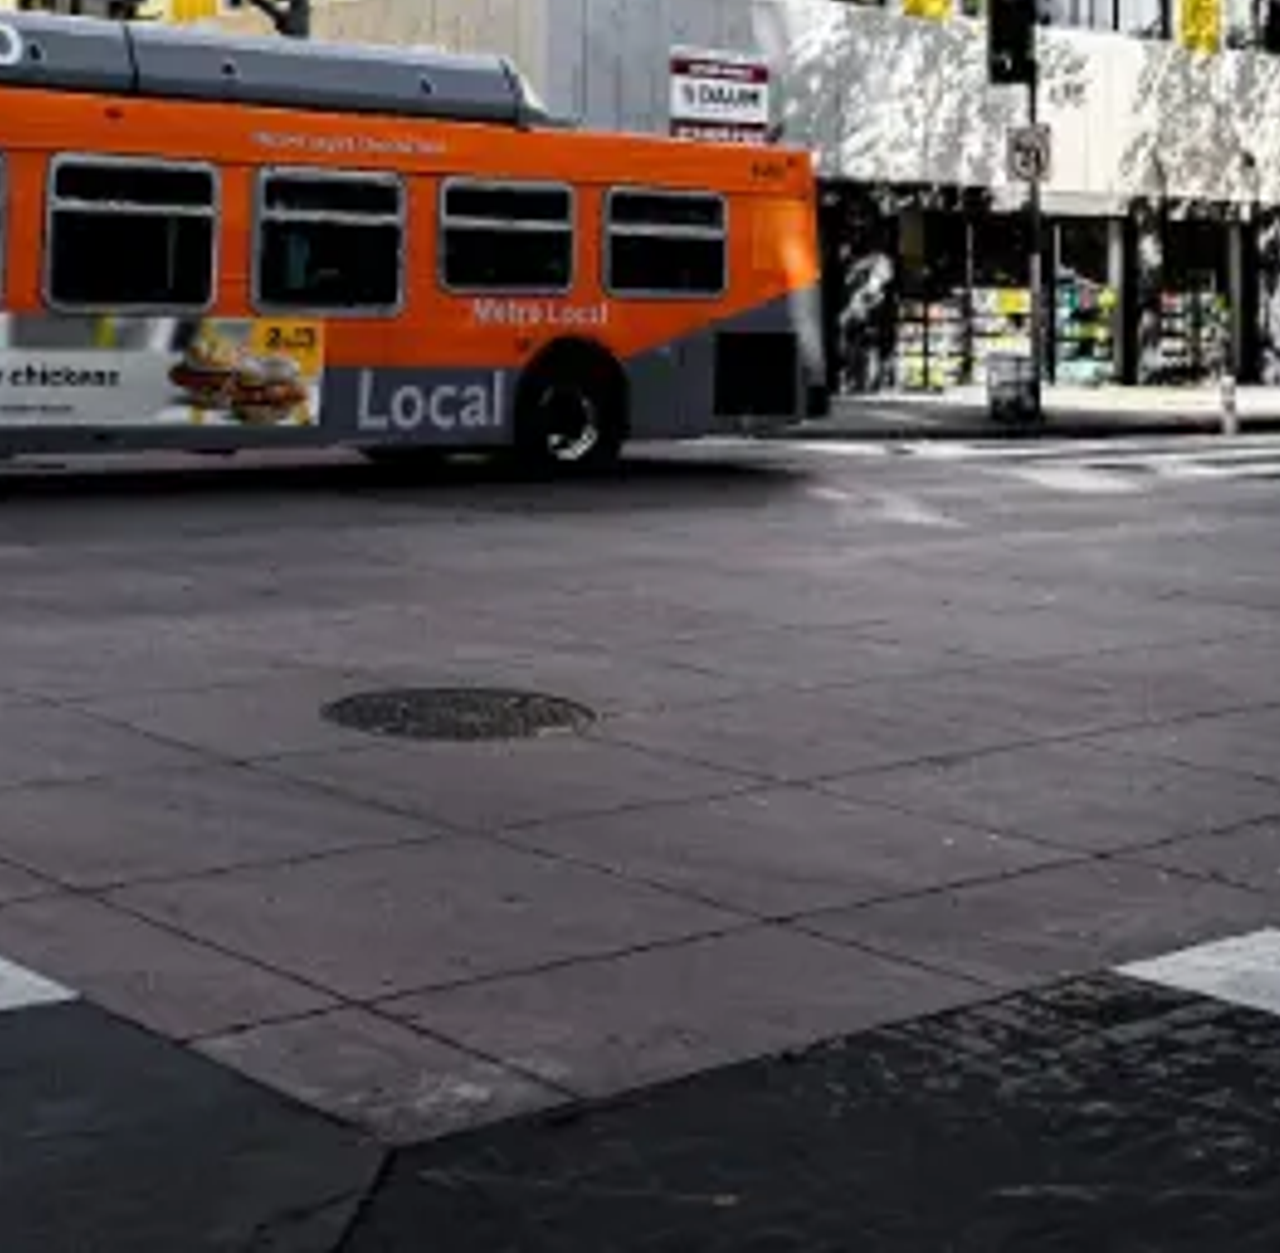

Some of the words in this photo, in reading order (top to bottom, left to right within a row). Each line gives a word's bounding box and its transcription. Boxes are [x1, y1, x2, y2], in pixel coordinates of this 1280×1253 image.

[474, 298, 543, 325] Metro
[547, 300, 609, 325] Local
[10, 364, 120, 387] chickens
[357, 368, 505, 431] Local
